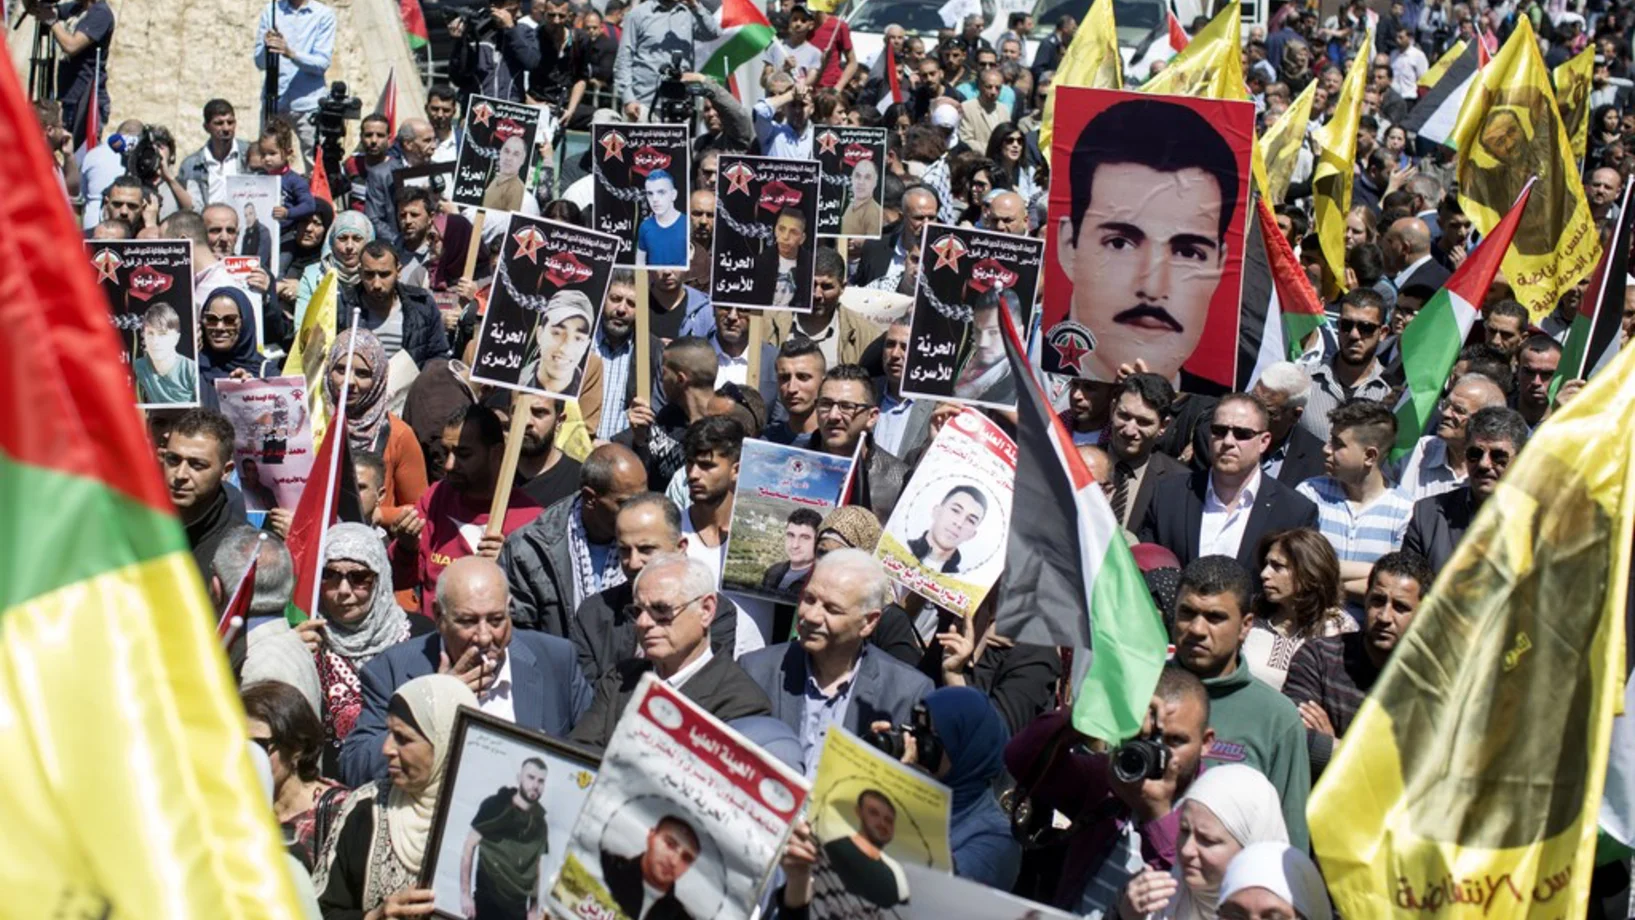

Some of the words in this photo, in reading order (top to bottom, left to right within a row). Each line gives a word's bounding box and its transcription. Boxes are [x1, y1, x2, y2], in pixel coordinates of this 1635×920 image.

[716, 276, 754, 292] للأسرى
[482, 351, 522, 368] للأسرى
[910, 363, 952, 380] للأسرى
